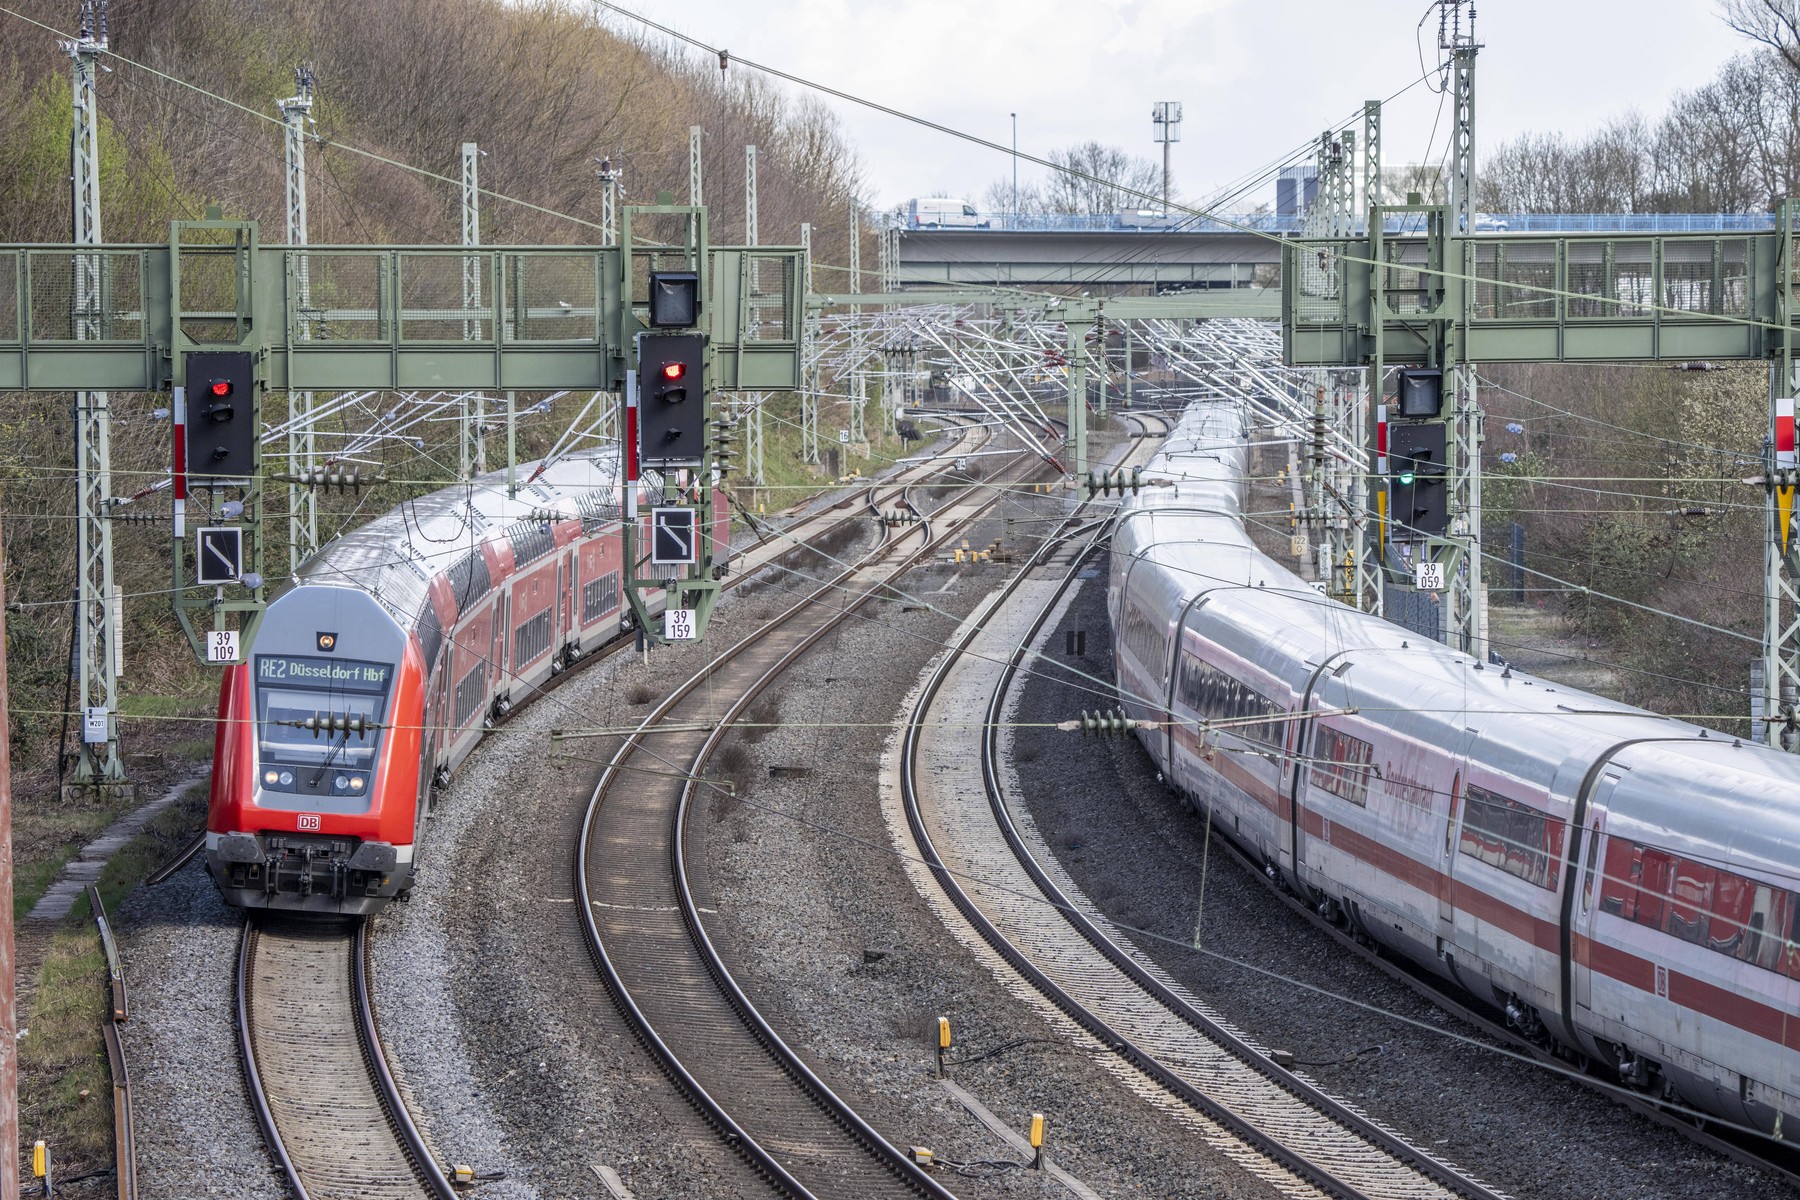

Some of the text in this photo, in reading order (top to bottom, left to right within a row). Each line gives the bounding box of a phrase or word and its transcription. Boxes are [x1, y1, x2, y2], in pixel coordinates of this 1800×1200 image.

[1424, 563, 1437, 576] 39
[1421, 576, 1440, 588] 059
[673, 610, 687, 624] 39
[671, 624, 690, 638] 159
[216, 631, 231, 646] 39
[213, 646, 234, 660] 109
[260, 658, 385, 682] RE2 Düsseldorf Hbf
[300, 817, 318, 828] DB
